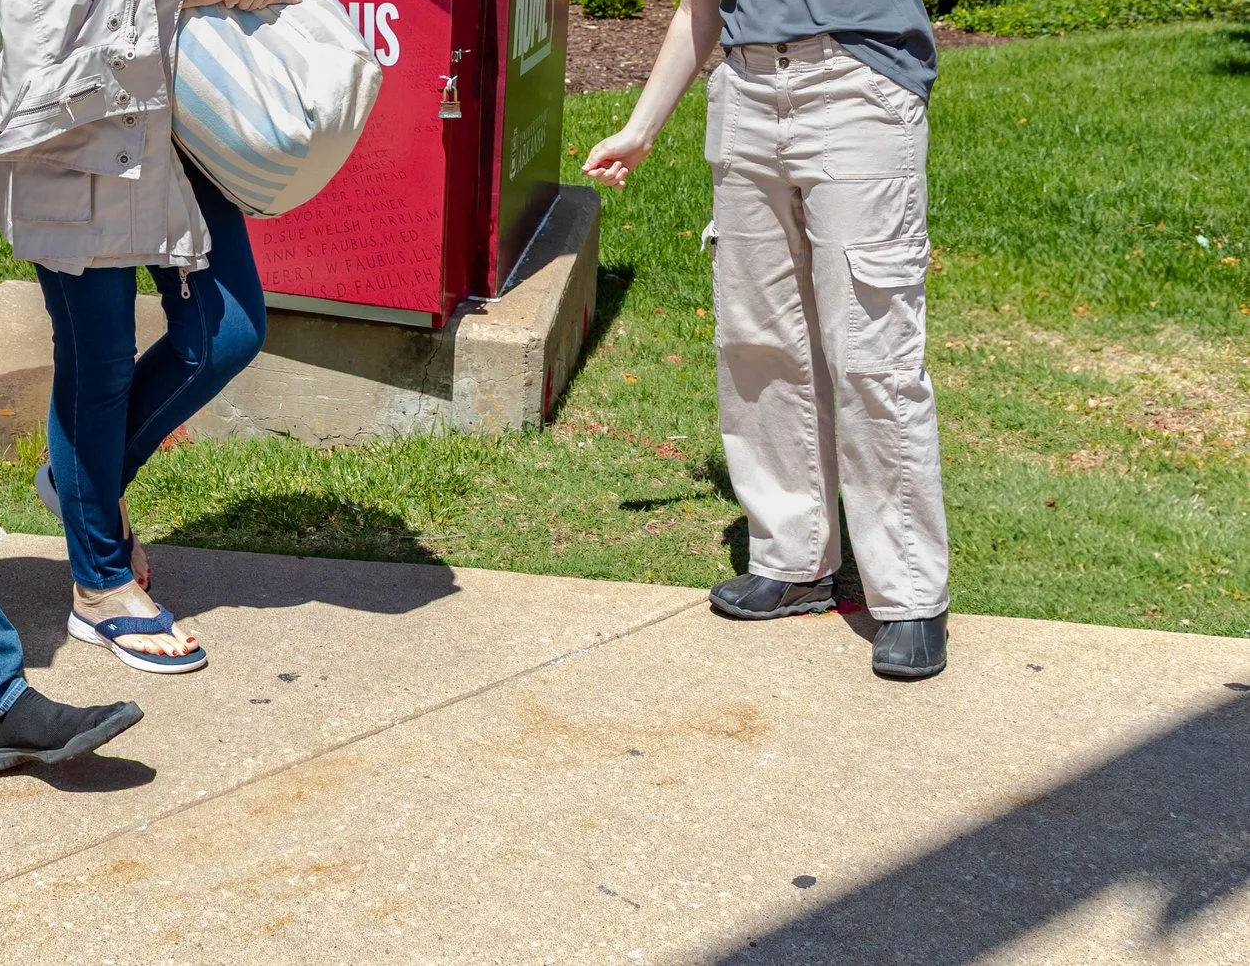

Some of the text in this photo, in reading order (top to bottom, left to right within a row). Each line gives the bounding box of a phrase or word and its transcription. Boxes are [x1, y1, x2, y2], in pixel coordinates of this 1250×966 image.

[355, 186, 388, 200] FALK
[313, 219, 360, 236] WELSH
[263, 265, 315, 286] JERRY
